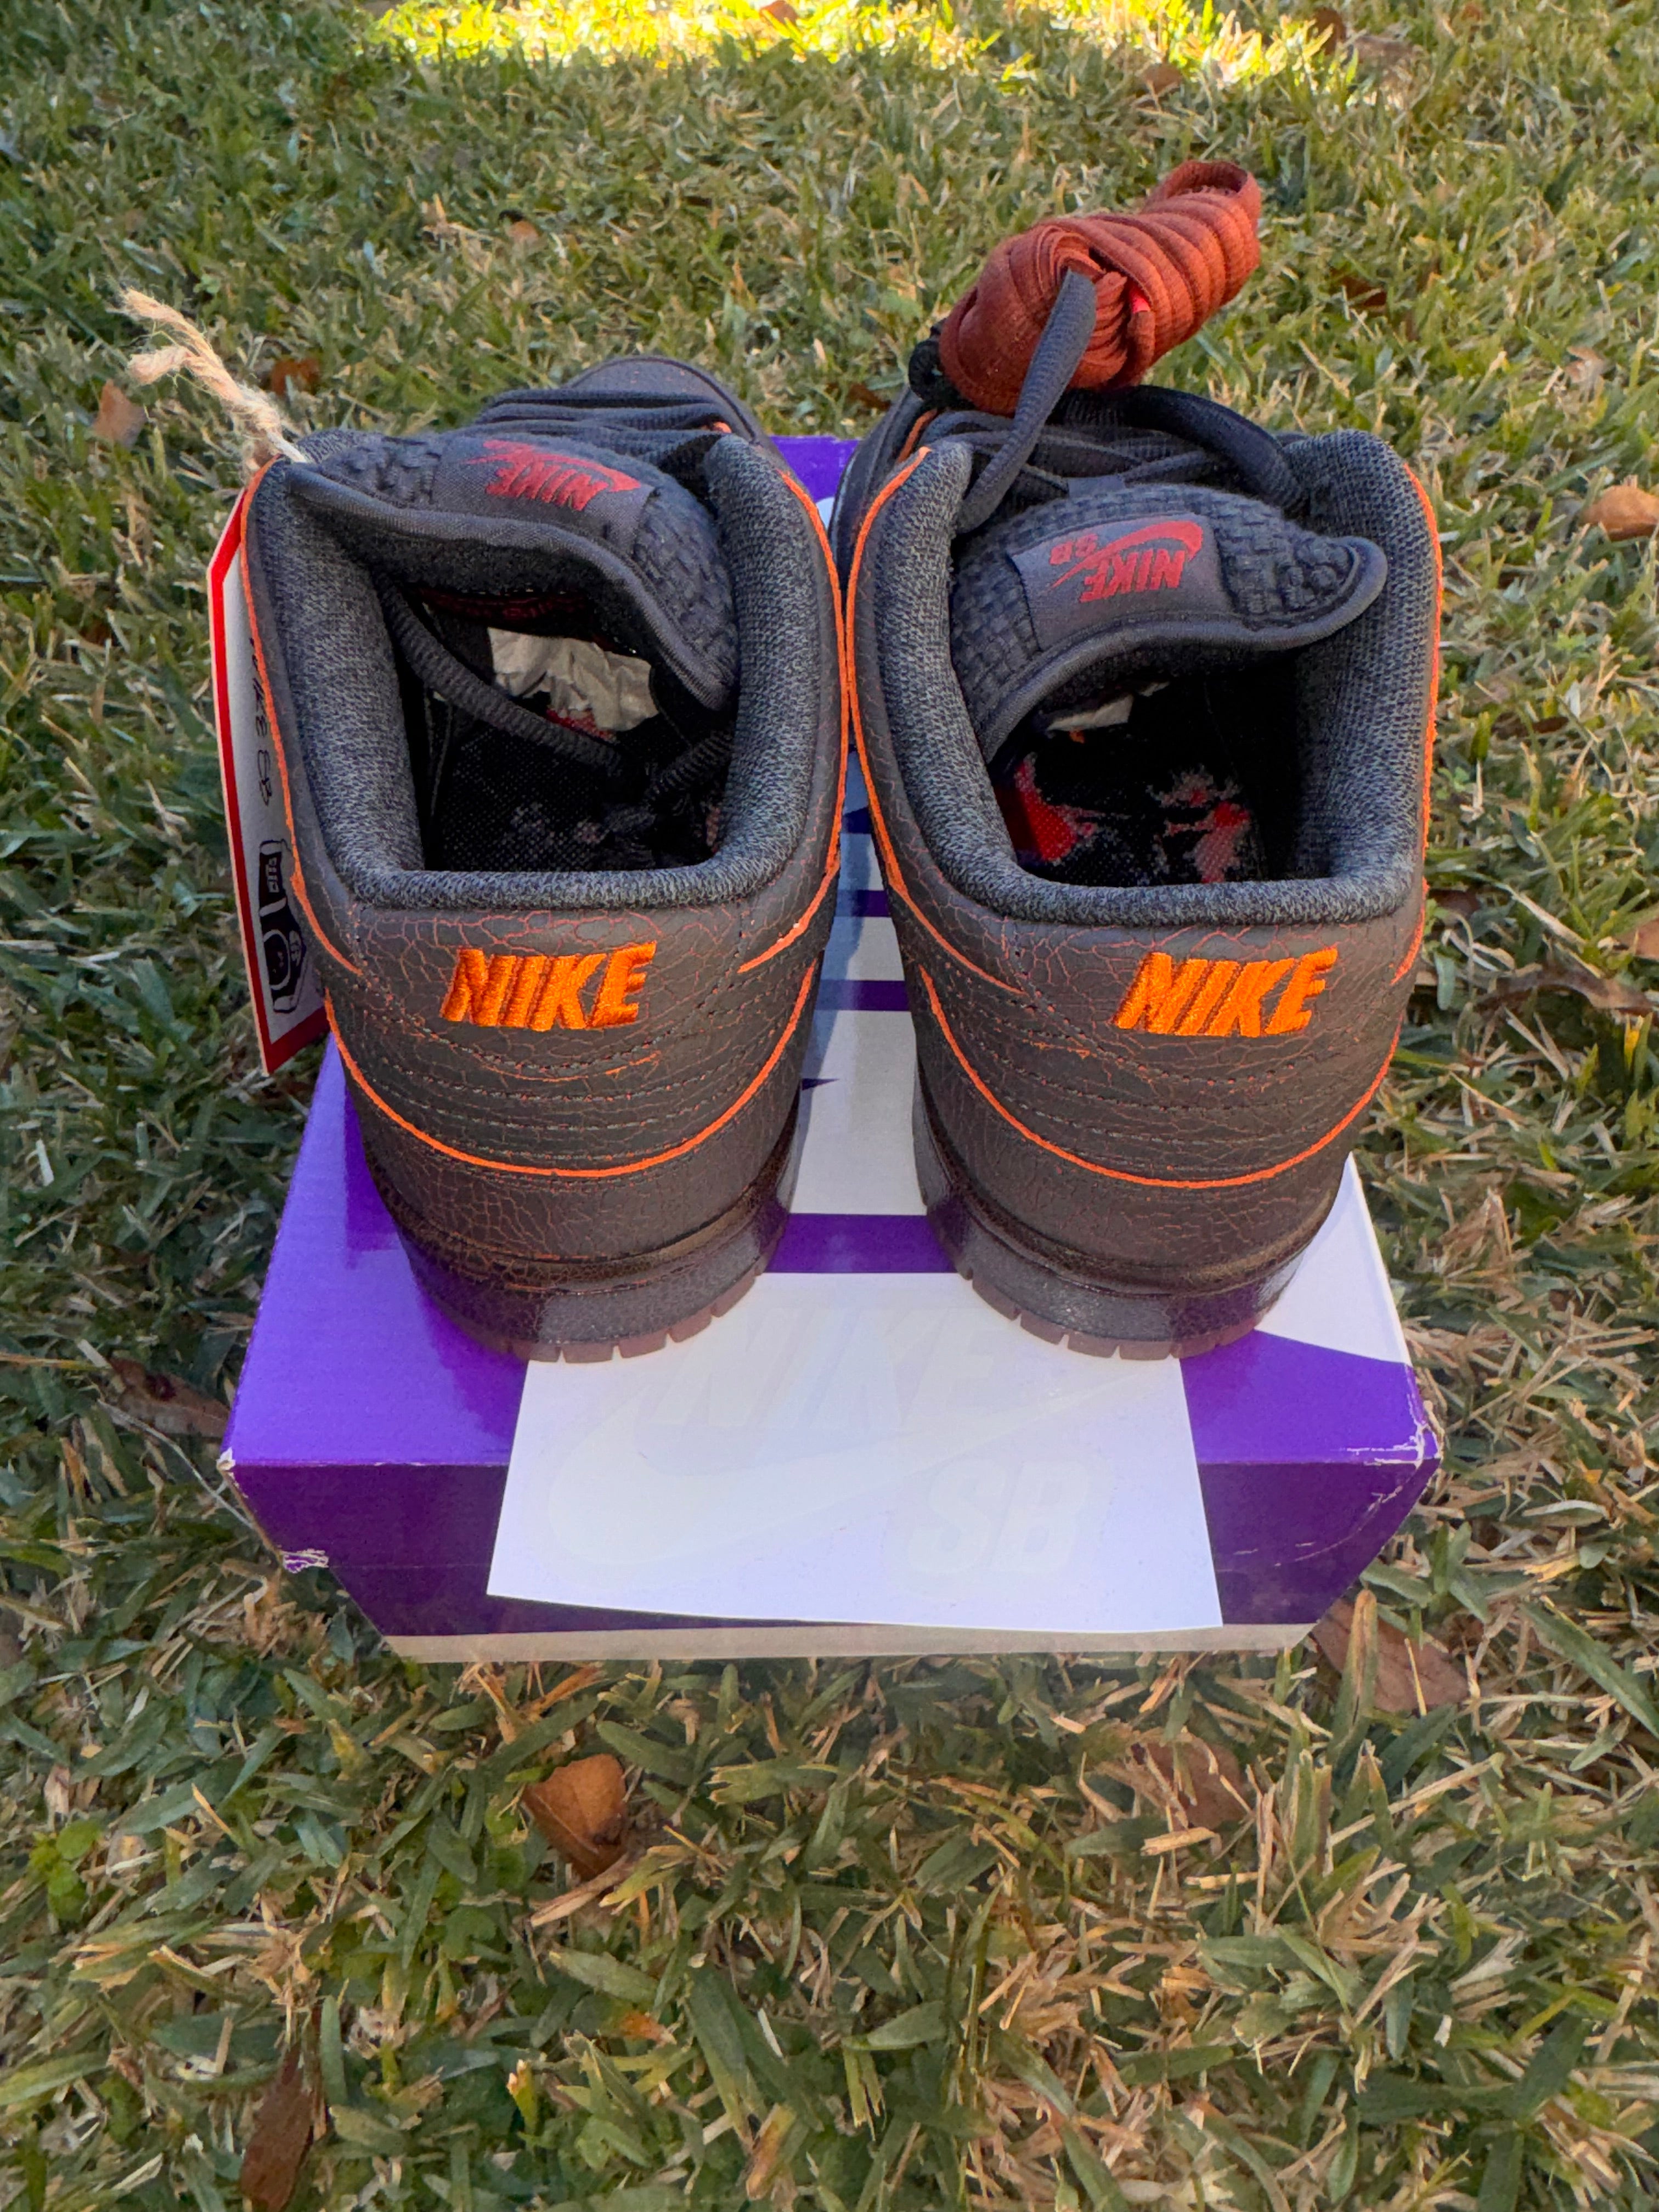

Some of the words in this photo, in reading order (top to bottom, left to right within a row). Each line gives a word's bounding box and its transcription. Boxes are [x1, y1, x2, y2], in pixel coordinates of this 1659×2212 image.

[486, 459, 608, 511] NIKE
[1079, 549, 1186, 603] NIKE
[441, 940, 657, 1031] NIKE
[1113, 947, 1339, 1038] NIKE
[907, 1458, 1091, 1576] SB
